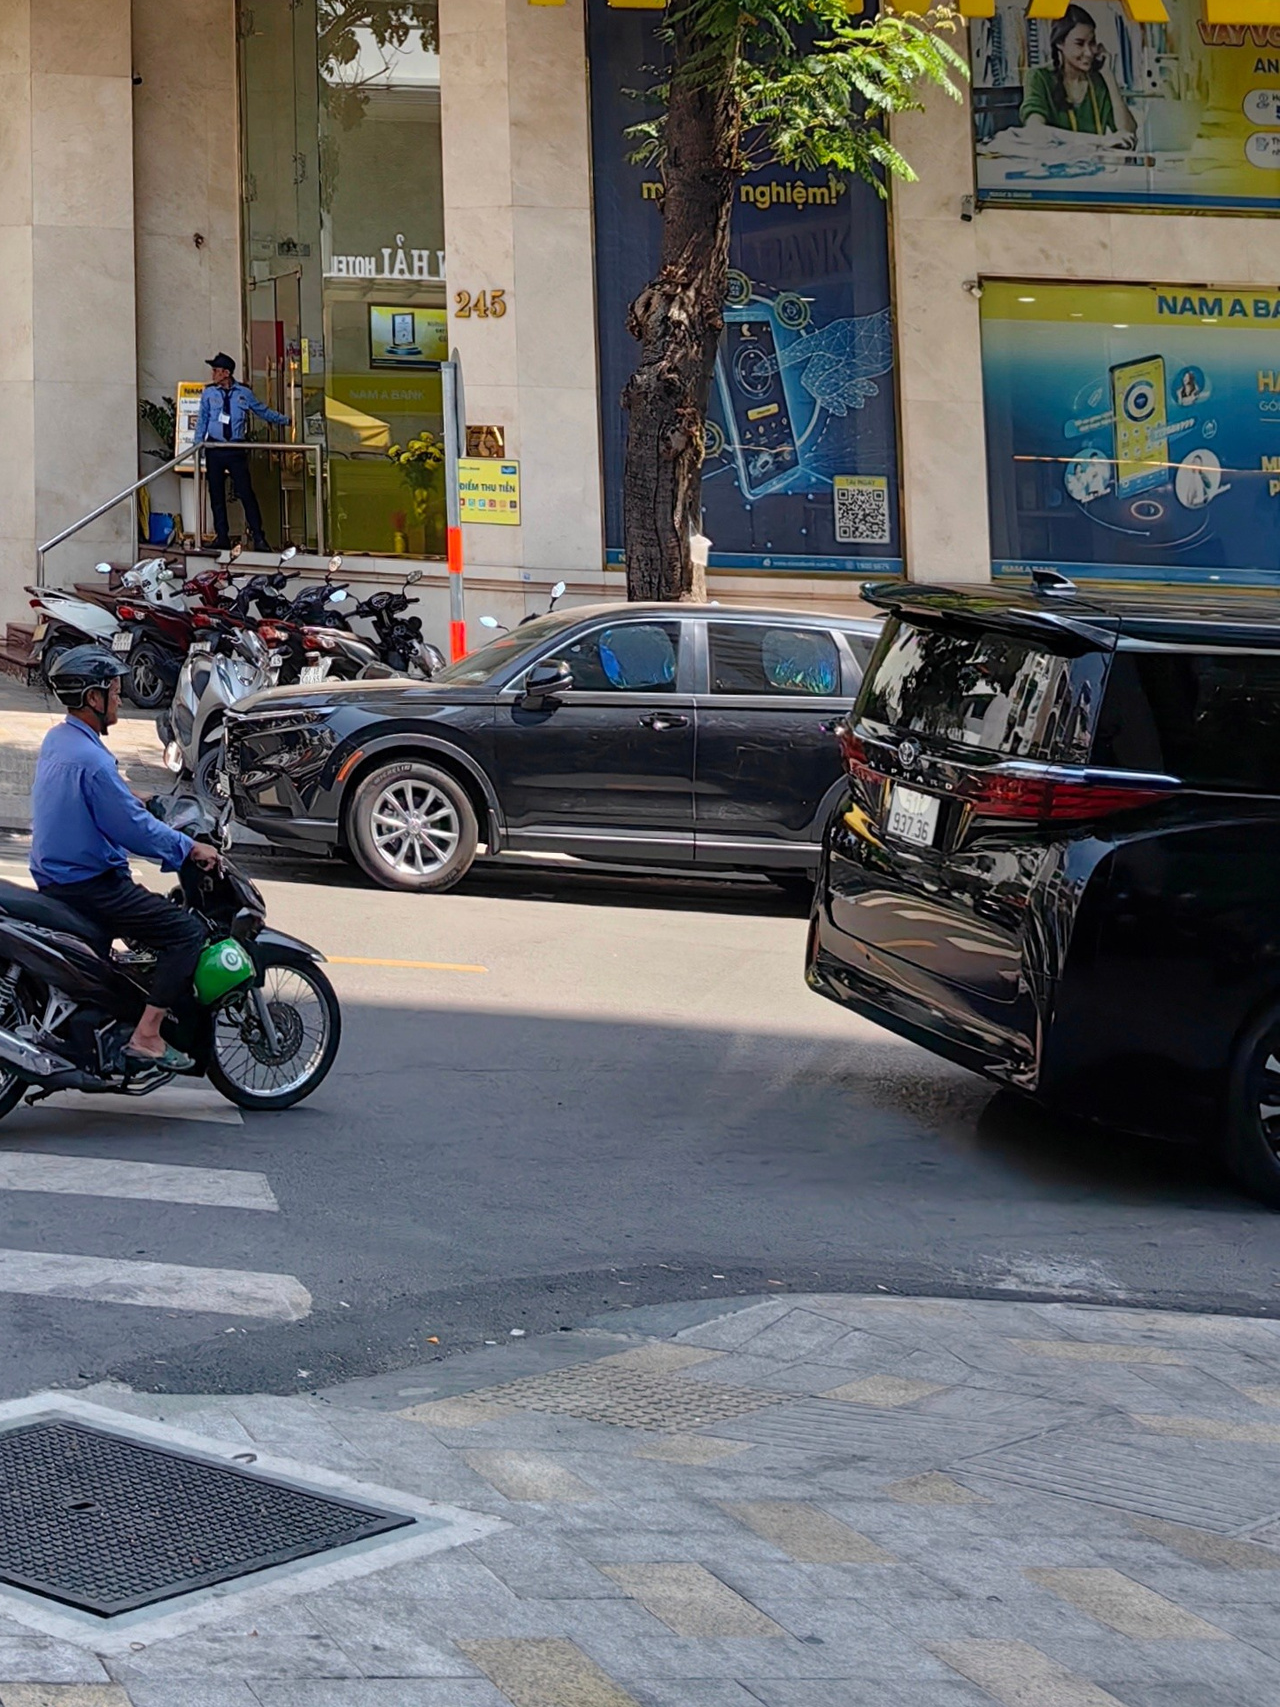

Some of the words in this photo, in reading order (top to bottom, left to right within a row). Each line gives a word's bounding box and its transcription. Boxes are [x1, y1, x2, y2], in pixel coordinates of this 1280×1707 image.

[454, 290, 507, 318] 245
[1157, 296, 1224, 316] NAM
[1228, 297, 1249, 318] A
